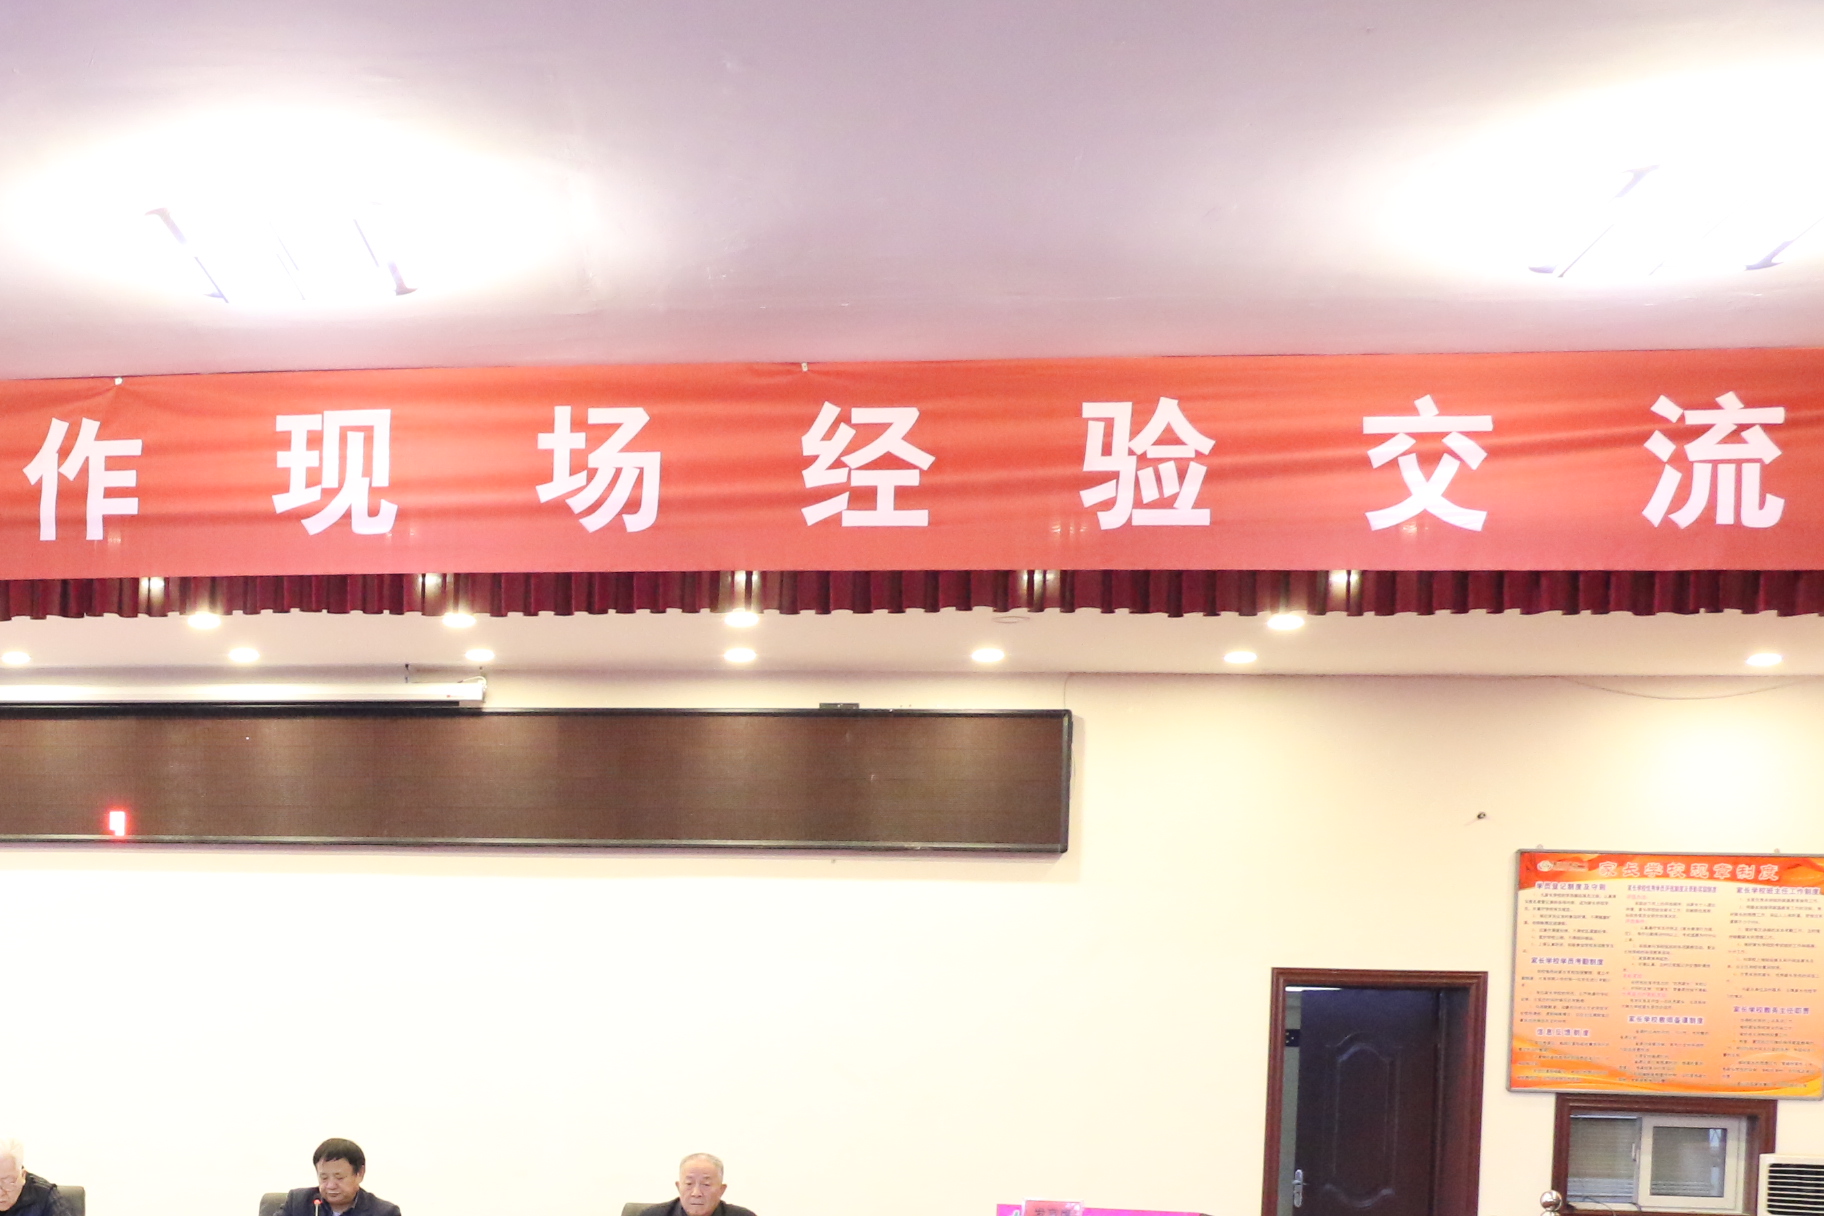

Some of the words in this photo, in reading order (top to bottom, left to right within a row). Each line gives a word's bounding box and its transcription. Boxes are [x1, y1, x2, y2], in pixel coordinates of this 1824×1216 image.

[1597, 860, 1780, 881] 家长学校规章制度
